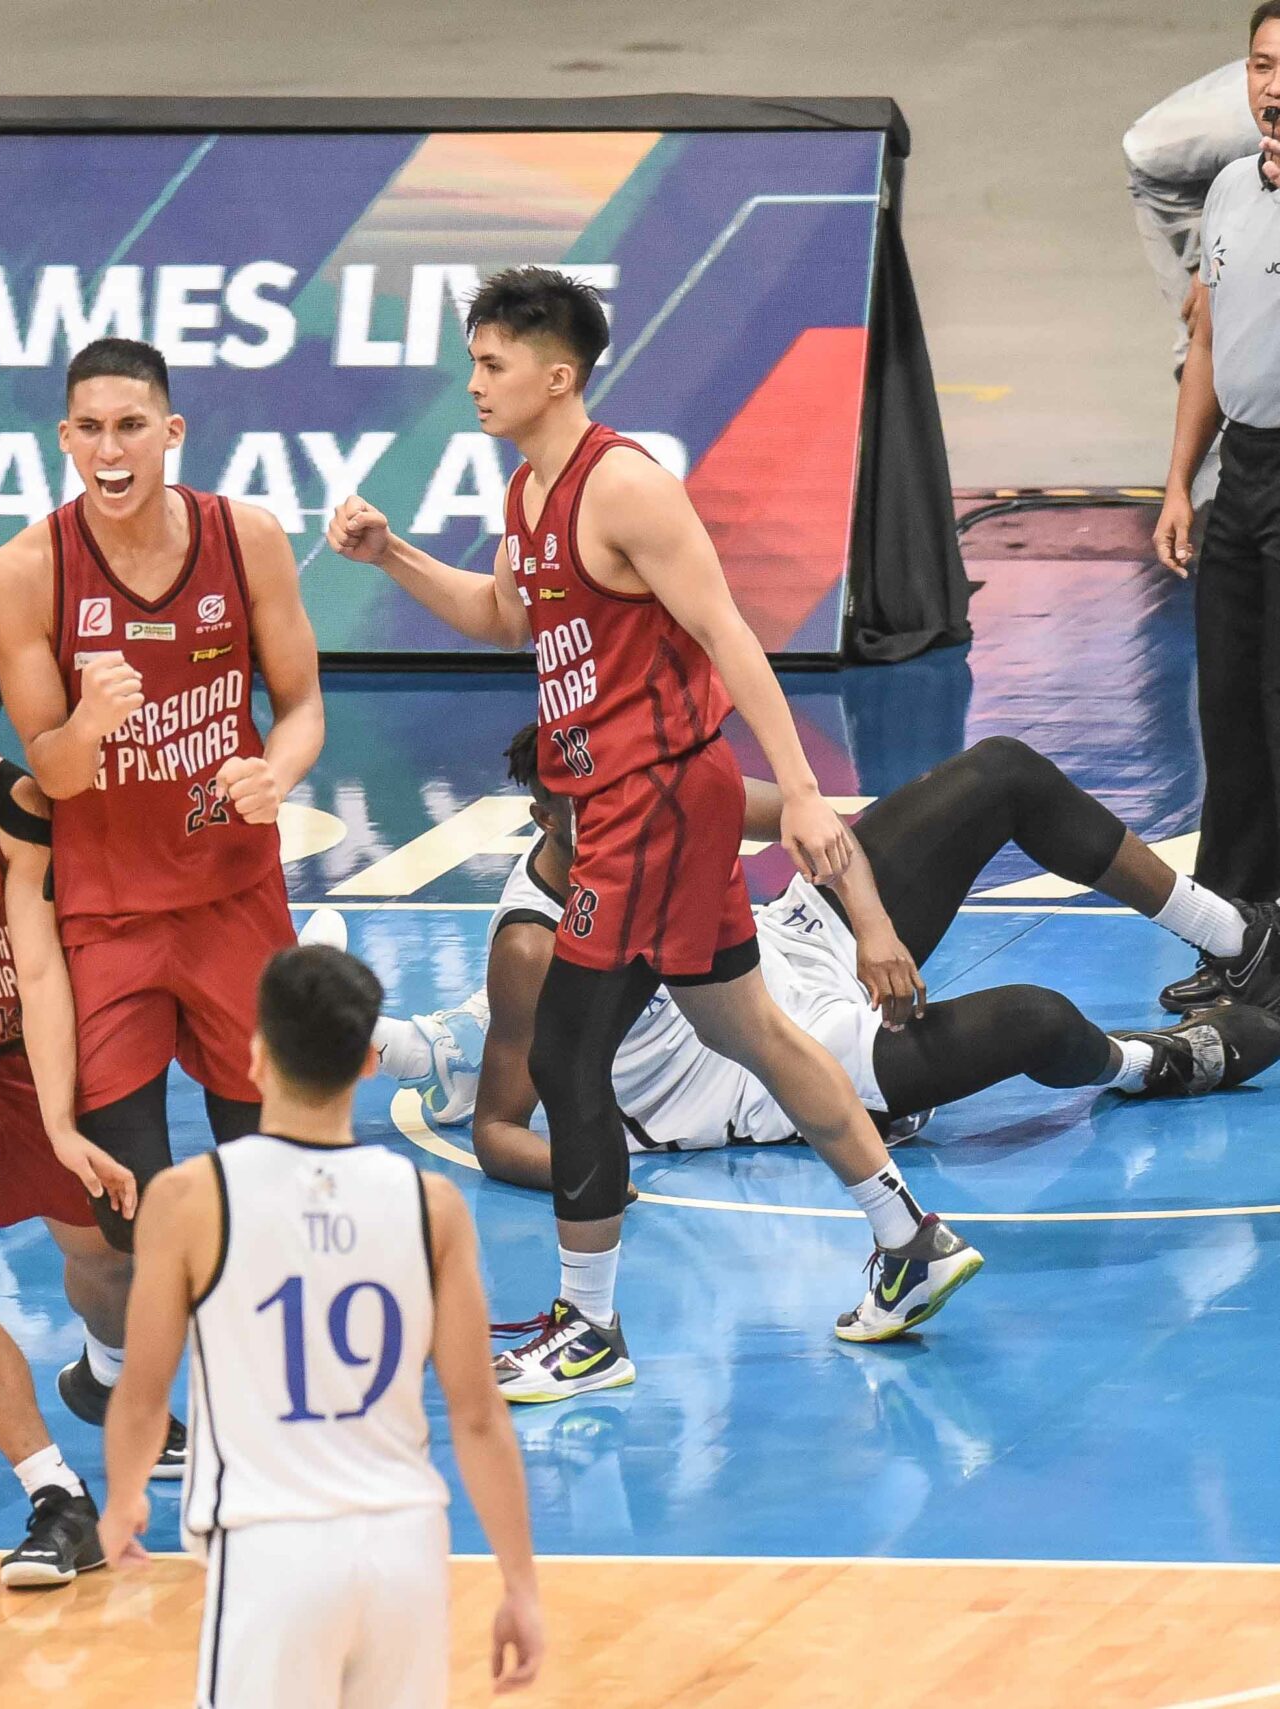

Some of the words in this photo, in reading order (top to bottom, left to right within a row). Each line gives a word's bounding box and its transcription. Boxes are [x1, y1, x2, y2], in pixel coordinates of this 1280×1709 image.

[551, 726, 594, 778] 18
[302, 1211, 357, 1255] TIO
[255, 1274, 404, 1424] 19
